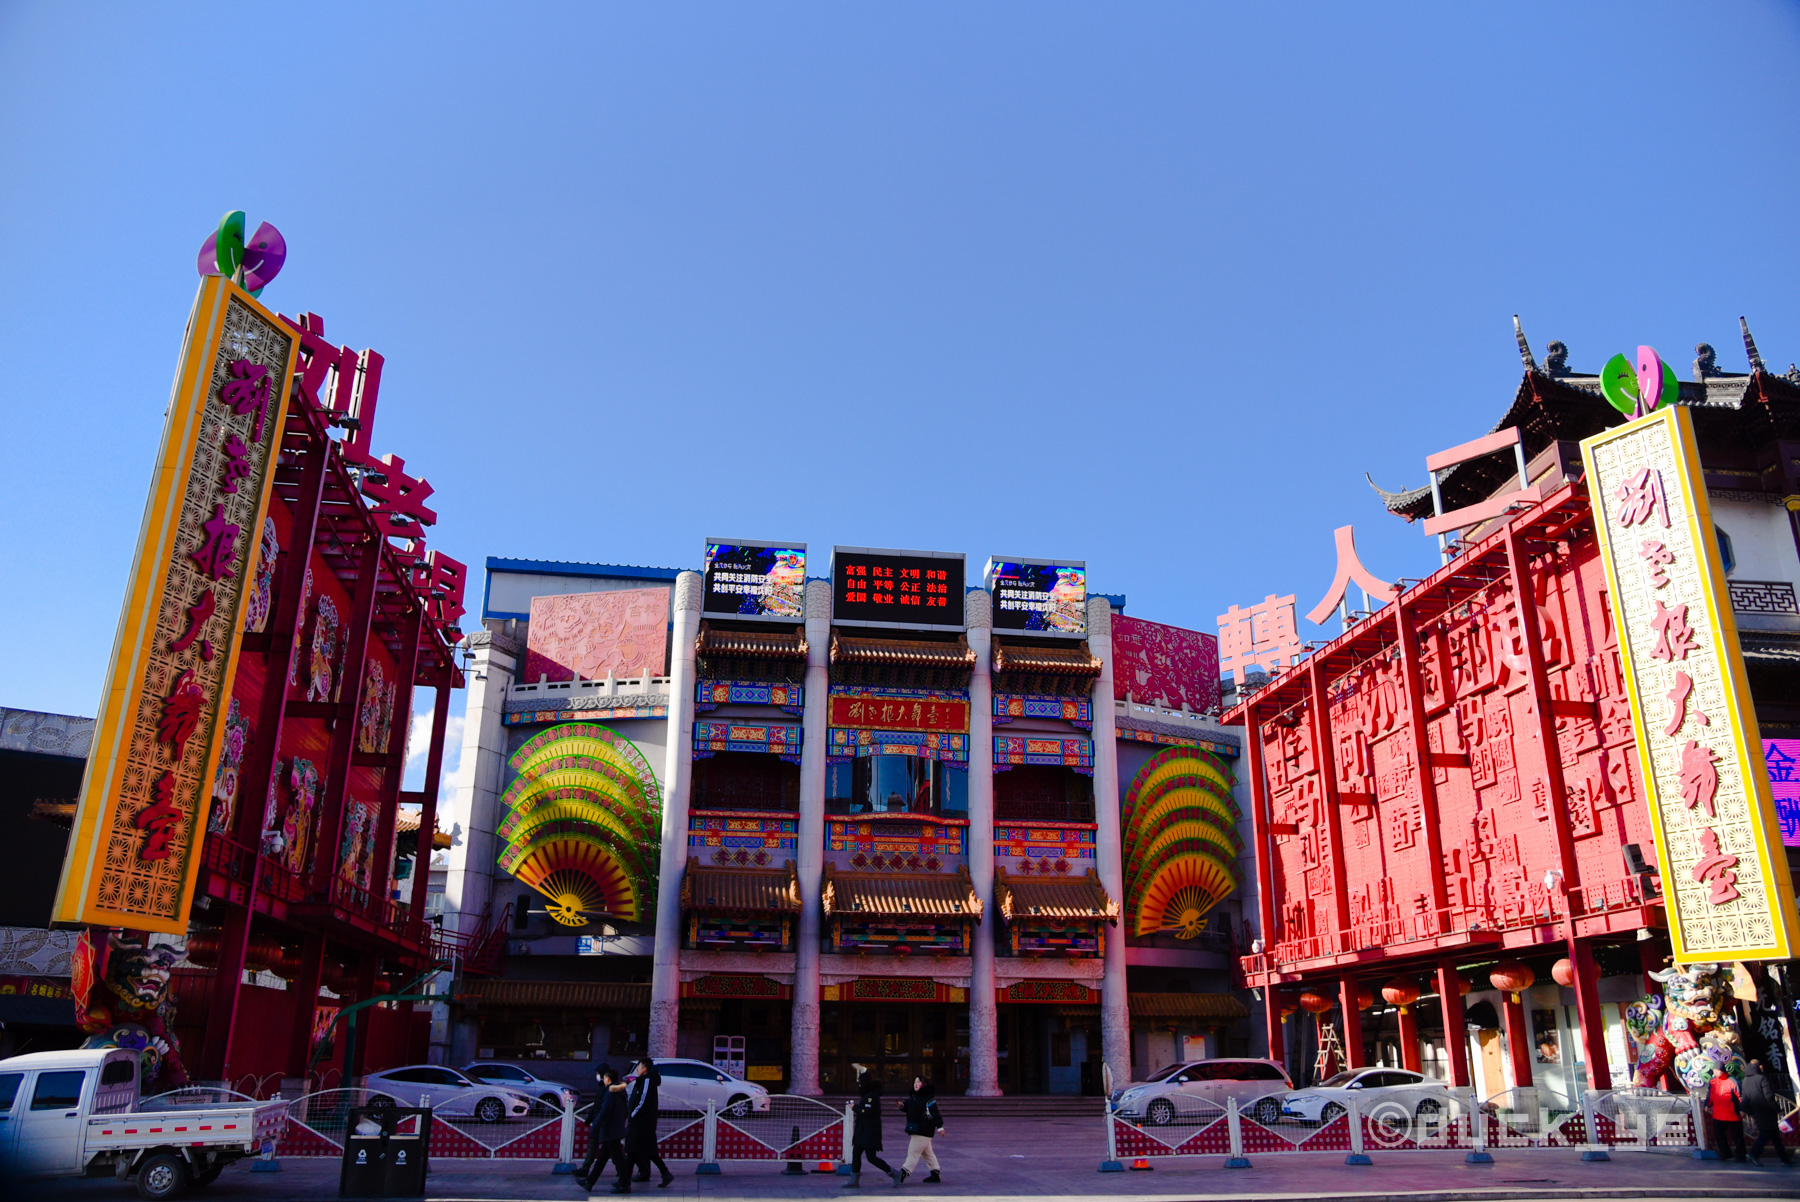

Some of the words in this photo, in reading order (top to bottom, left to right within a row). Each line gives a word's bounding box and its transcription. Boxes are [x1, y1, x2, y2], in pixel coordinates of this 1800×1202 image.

[846, 564, 867, 576] 富强
[873, 566, 893, 578] 民主
[899, 568, 920, 579] 文明
[926, 569, 947, 581] 和谐
[847, 578, 867, 589] 自由
[873, 580, 894, 591] 平等
[900, 581, 921, 592] 公正
[926, 582, 947, 594] 法治
[846, 591, 867, 603] 爱国
[872, 592, 894, 604] 敬业
[900, 594, 920, 606] 诚信
[926, 596, 947, 607] 友善
